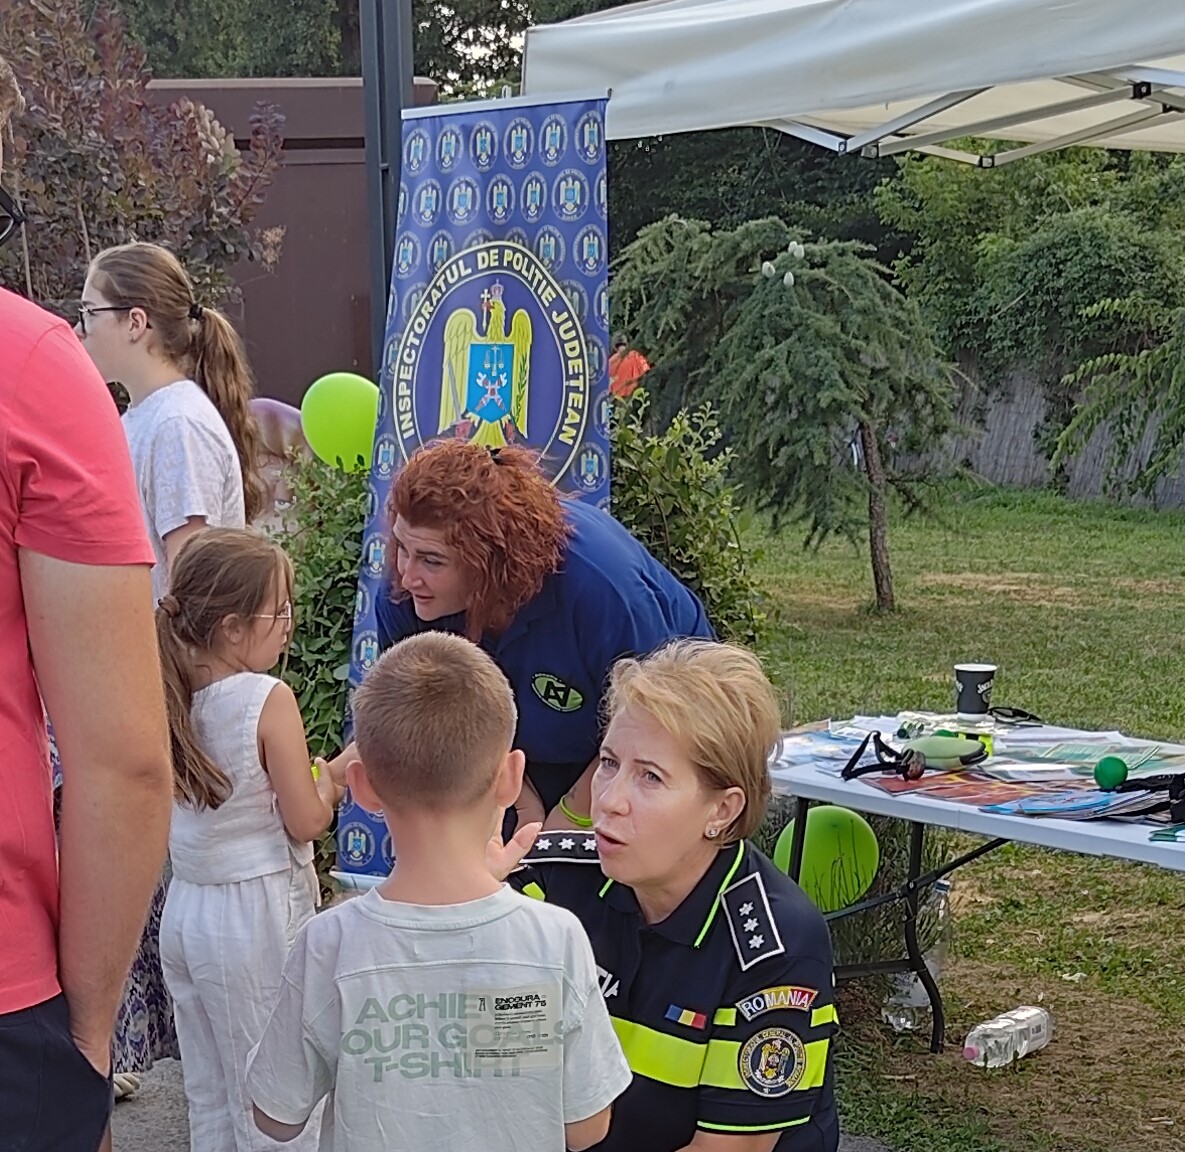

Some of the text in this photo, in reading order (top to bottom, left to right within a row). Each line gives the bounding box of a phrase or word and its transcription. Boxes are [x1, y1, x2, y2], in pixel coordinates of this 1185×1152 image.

[398, 260, 473, 439] INSPECTORATUL
[477, 248, 499, 270] DE
[741, 990, 810, 1018] ROMANIA
[340, 1023, 429, 1056] OUR
